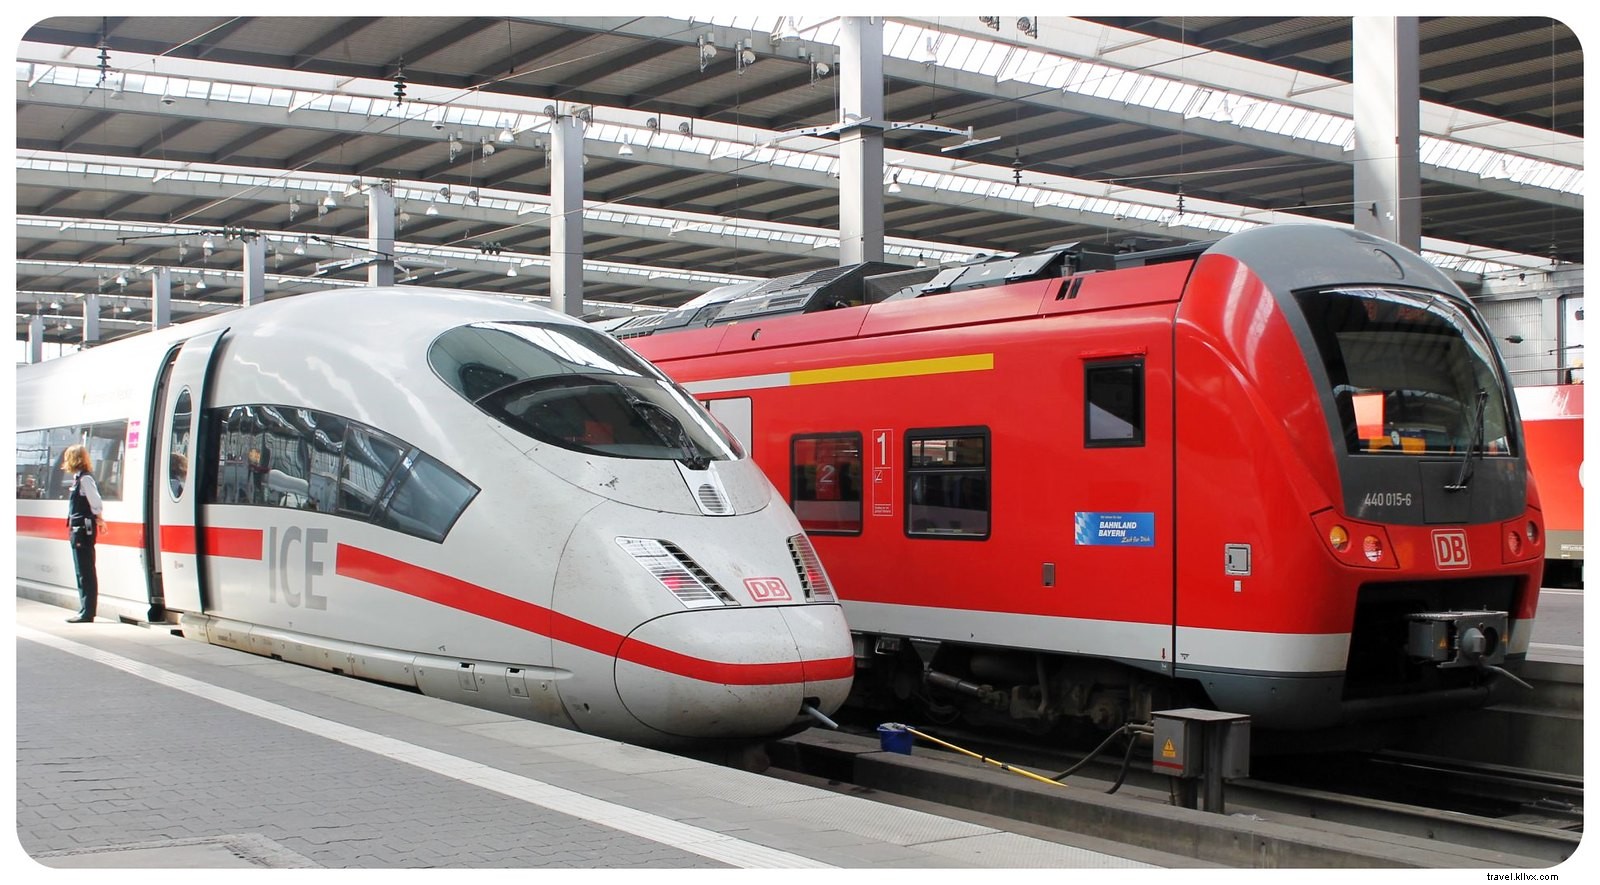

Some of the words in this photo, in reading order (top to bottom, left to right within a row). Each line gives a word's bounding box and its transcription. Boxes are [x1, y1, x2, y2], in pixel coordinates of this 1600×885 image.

[876, 432, 886, 466] 1
[819, 464, 835, 483] 2
[1364, 492, 1384, 506] 440
[1385, 492, 1412, 506] 015-6
[1098, 529, 1126, 537] BAYERN
[1099, 521, 1137, 529] BAHNLAND
[1435, 534, 1468, 565] DB
[269, 525, 328, 611] ICE
[748, 579, 788, 599] DB
